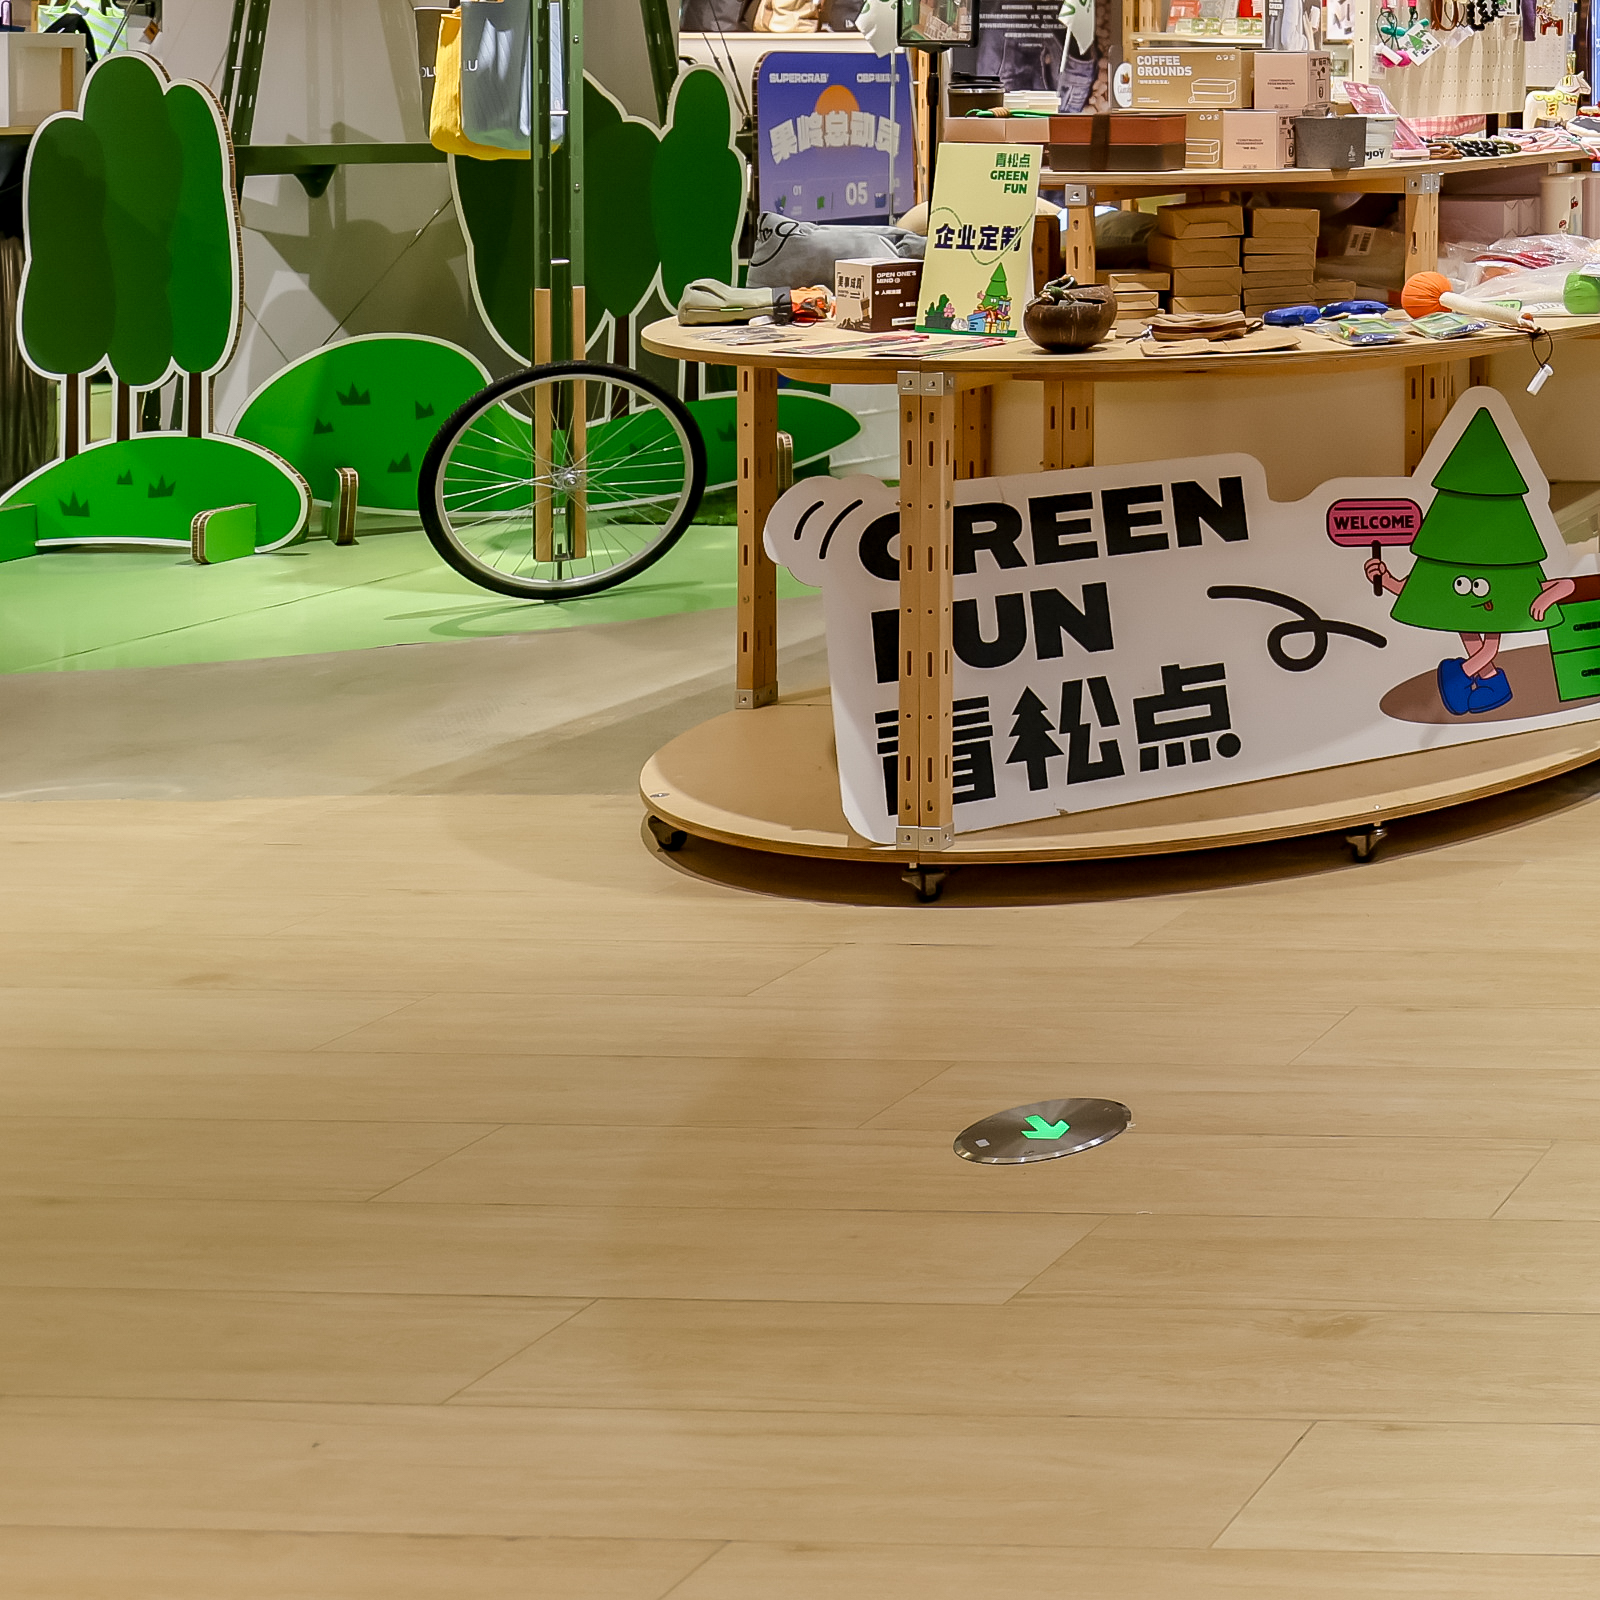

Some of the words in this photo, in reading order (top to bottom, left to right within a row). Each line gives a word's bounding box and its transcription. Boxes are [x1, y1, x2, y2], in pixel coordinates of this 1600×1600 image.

[1137, 56, 1180, 65] COFFEE
[1137, 66, 1192, 76] GROUNDS
[996, 153, 1031, 167] 青松点
[990, 170, 1029, 181] GREEN
[792, 185, 802, 196] 01
[845, 182, 868, 205] 05
[1003, 183, 1027, 194] FUN
[934, 223, 1022, 251] 企业定制
[876, 271, 896, 279] OPEN
[1334, 514, 1414, 531] WELCOME
[876, 662, 1242, 816] 青松点
